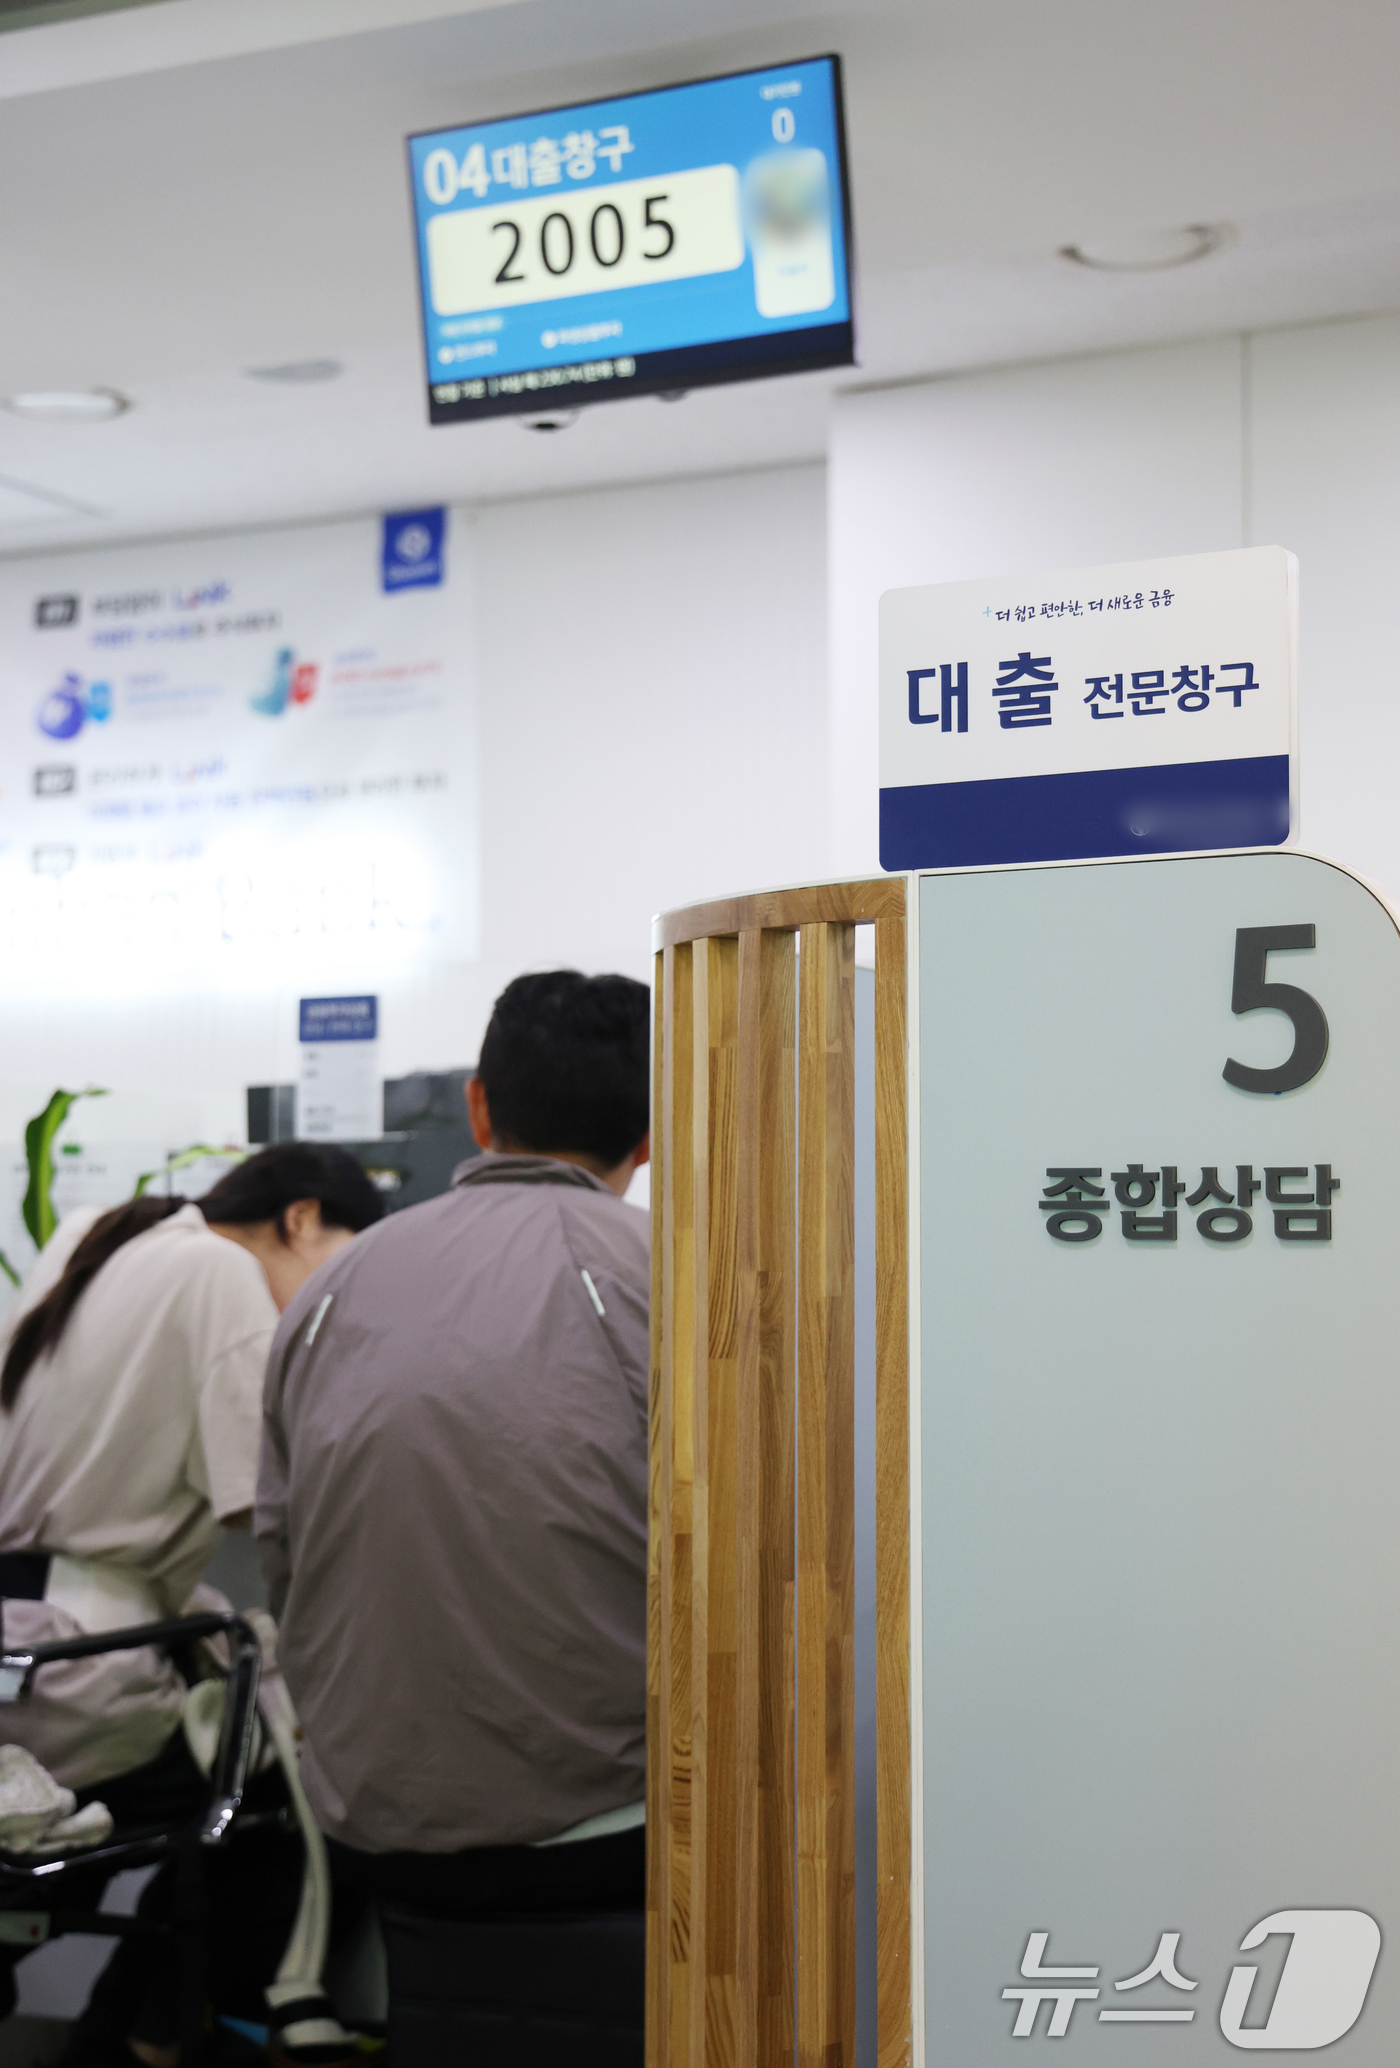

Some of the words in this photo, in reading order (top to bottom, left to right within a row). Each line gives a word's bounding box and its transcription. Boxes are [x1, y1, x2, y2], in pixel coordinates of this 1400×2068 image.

[771, 107, 796, 145] 0
[490, 194, 676, 285] 2005
[995, 608, 1011, 622] 더
[1014, 605, 1036, 623] 쉽고
[1088, 598, 1104, 612] 더
[1107, 592, 1145, 611] 새로운
[1148, 588, 1175, 608] 금융
[1083, 661, 1260, 720] 전문창구
[1222, 923, 1330, 1094] 5
[1038, 1163, 1341, 1242] 종합상담
